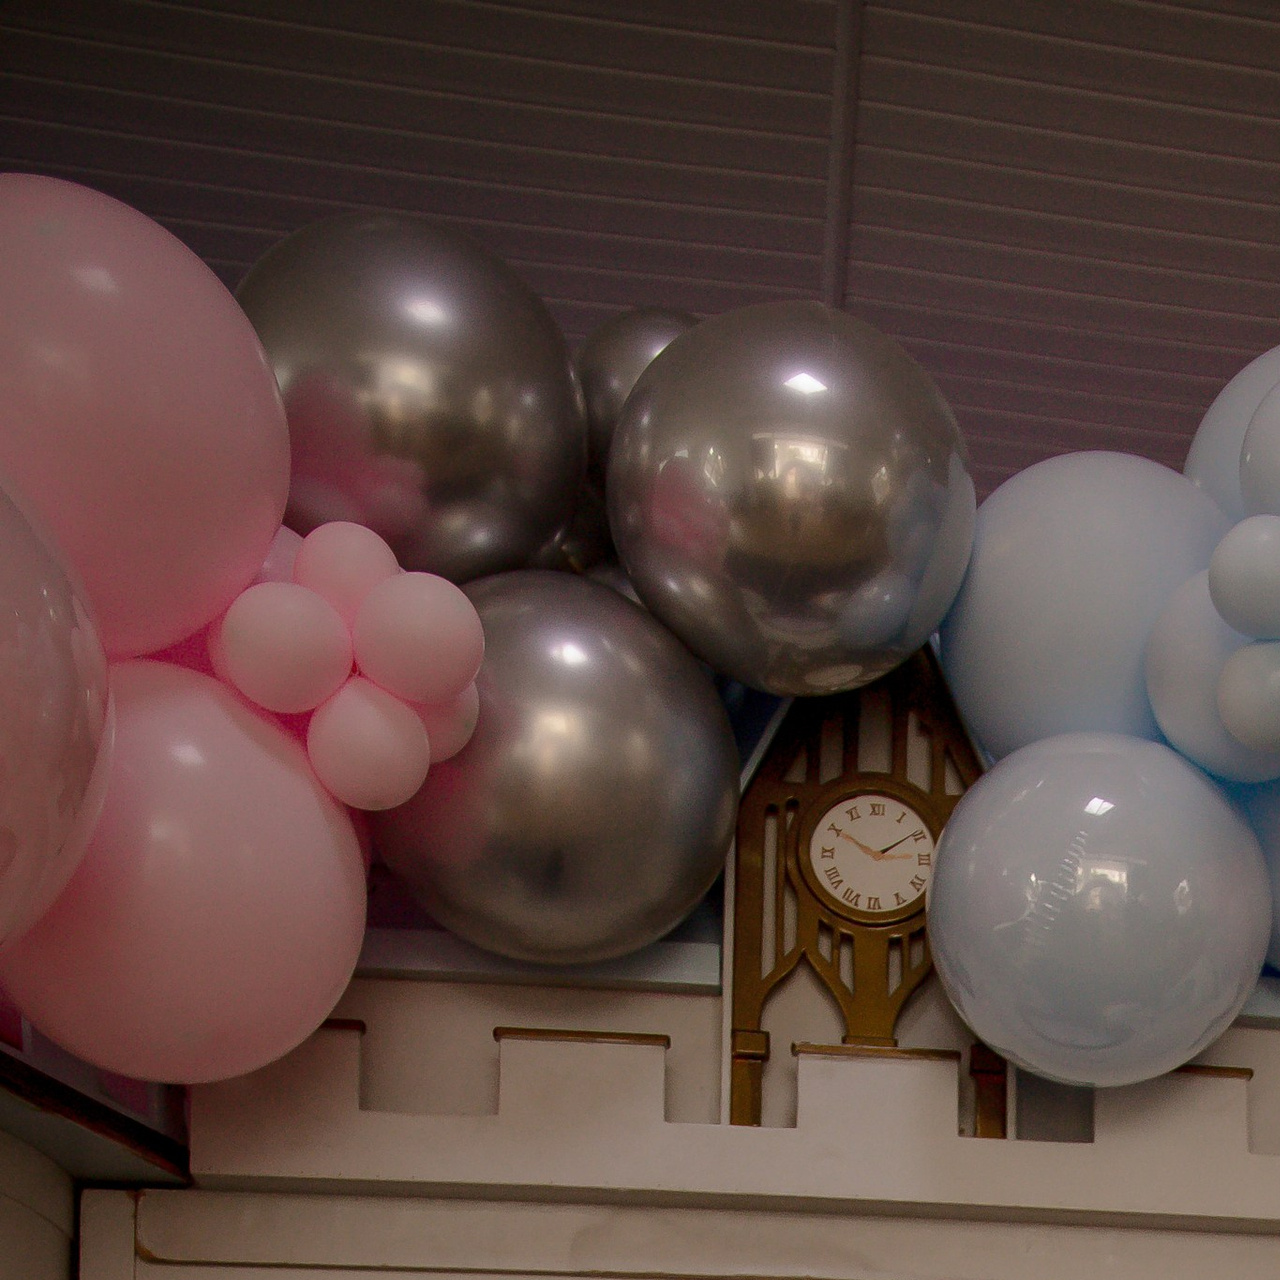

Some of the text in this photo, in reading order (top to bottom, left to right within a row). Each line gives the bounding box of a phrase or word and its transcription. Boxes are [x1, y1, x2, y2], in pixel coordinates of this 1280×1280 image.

[846, 806, 861, 821] XI
[870, 803, 885, 816] XII
[896, 812, 906, 823] I
[821, 847, 834, 859] IX
[918, 853, 930, 865] III
[825, 867, 843, 889] VIII
[910, 875, 926, 891] IV
[842, 888, 861, 907] VII
[867, 897, 881, 909] VI
[894, 893, 907, 906] V
